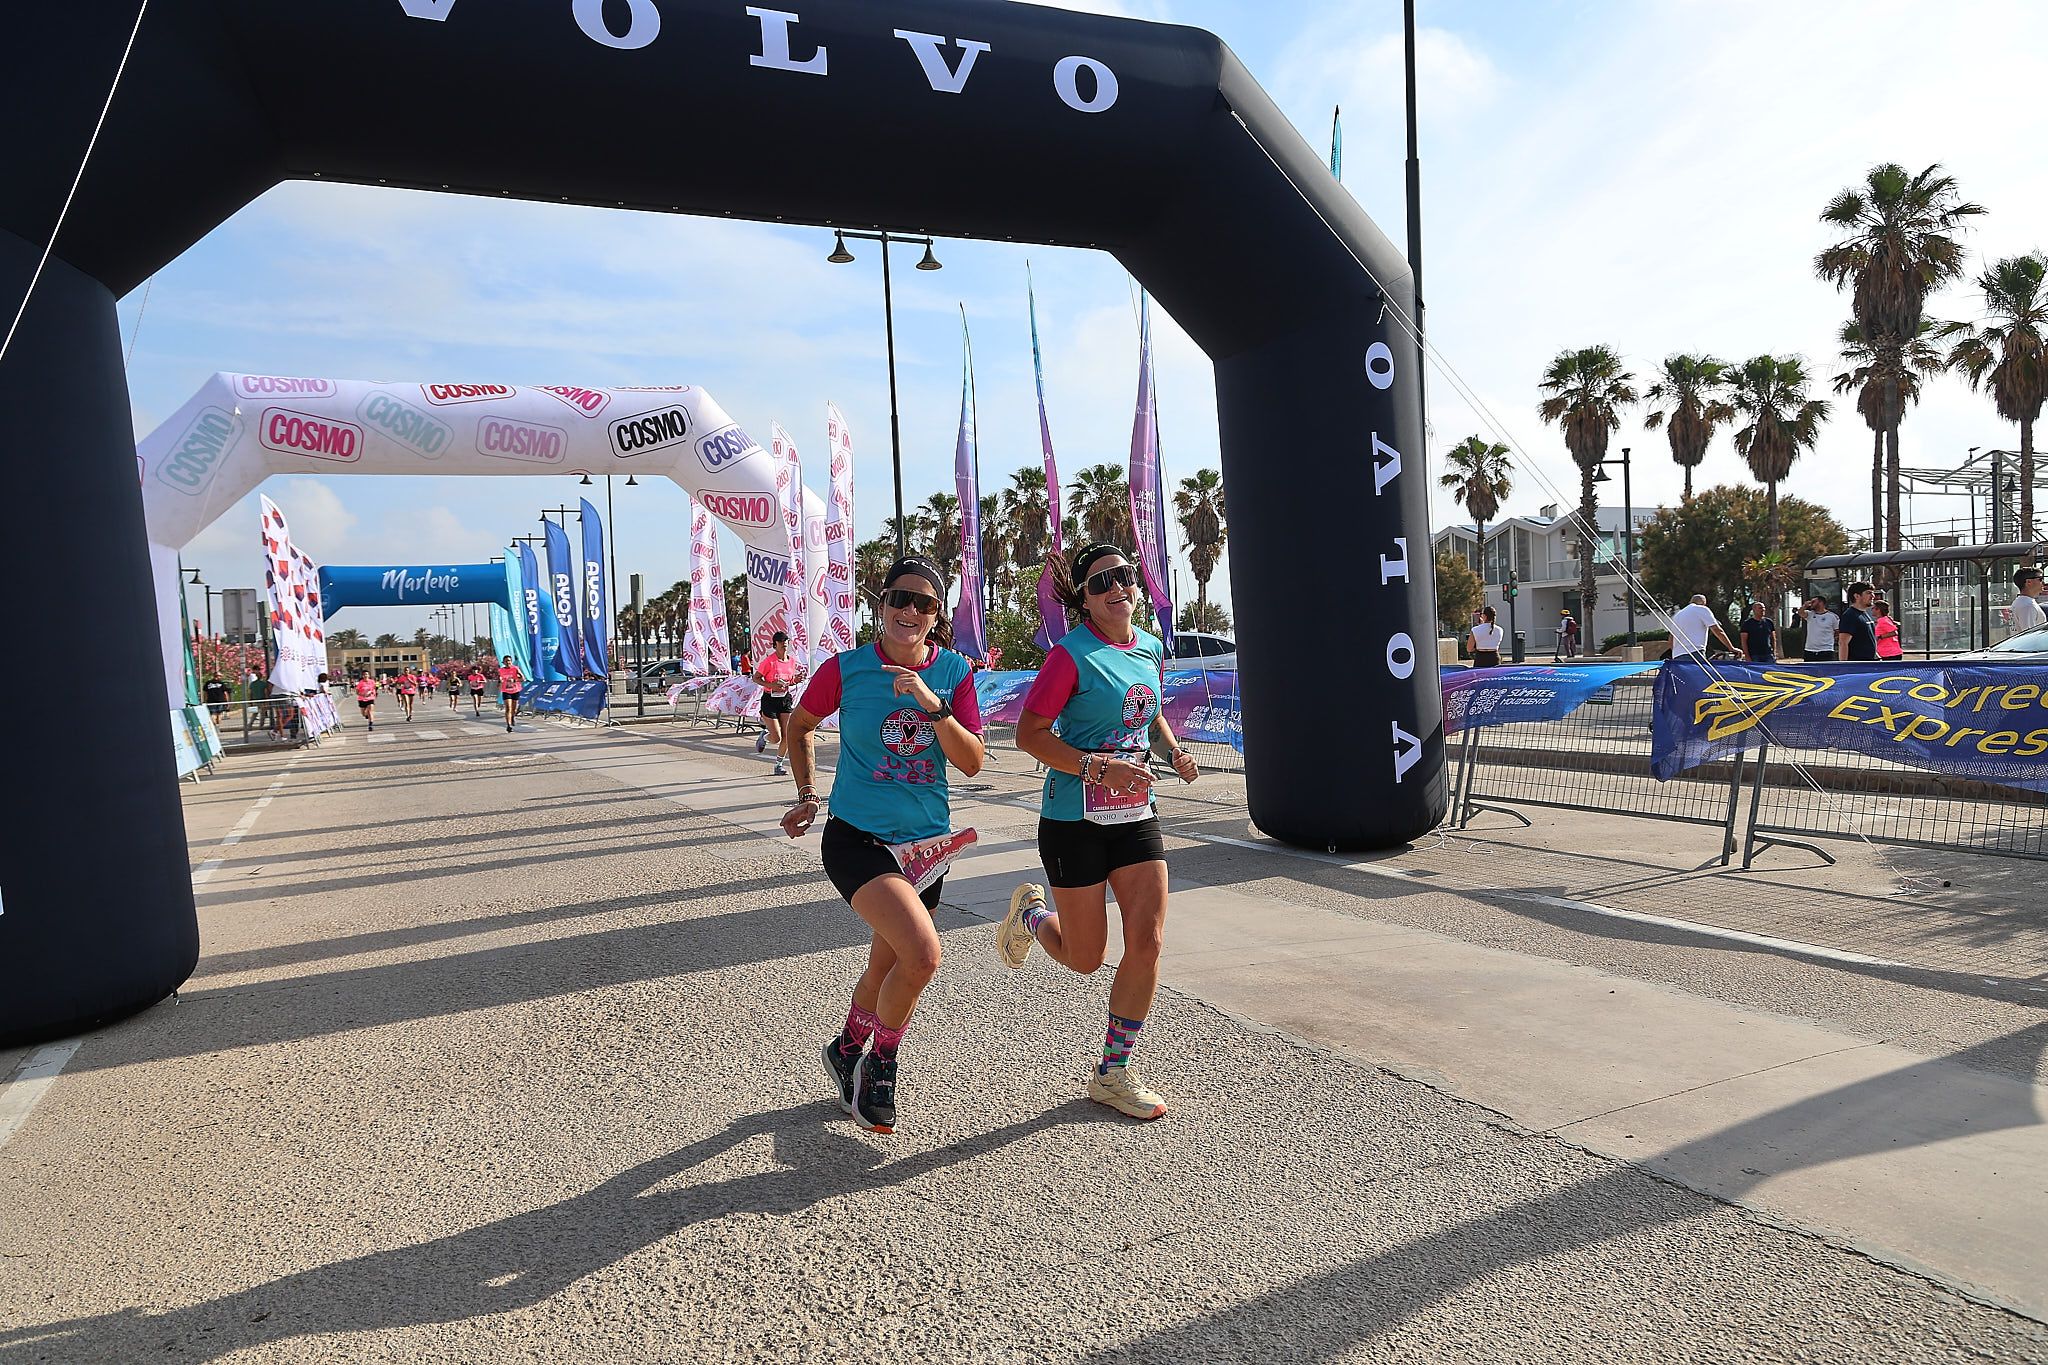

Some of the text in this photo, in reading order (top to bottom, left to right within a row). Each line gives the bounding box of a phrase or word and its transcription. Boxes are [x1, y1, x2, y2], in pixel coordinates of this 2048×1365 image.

[269, 414, 355, 457] COSMO
[366, 396, 445, 453] COSMO
[484, 421, 561, 458] COSMO
[617, 410, 686, 451] COSMO
[166, 413, 232, 486] COSMO
[703, 494, 769, 523] COSMO
[747, 551, 788, 586] COSM
[1365, 341, 1424, 784] VOLVO
[381, 568, 459, 600] Marlene
[1869, 677, 2048, 712] Corre
[1828, 695, 2048, 756] Expres
